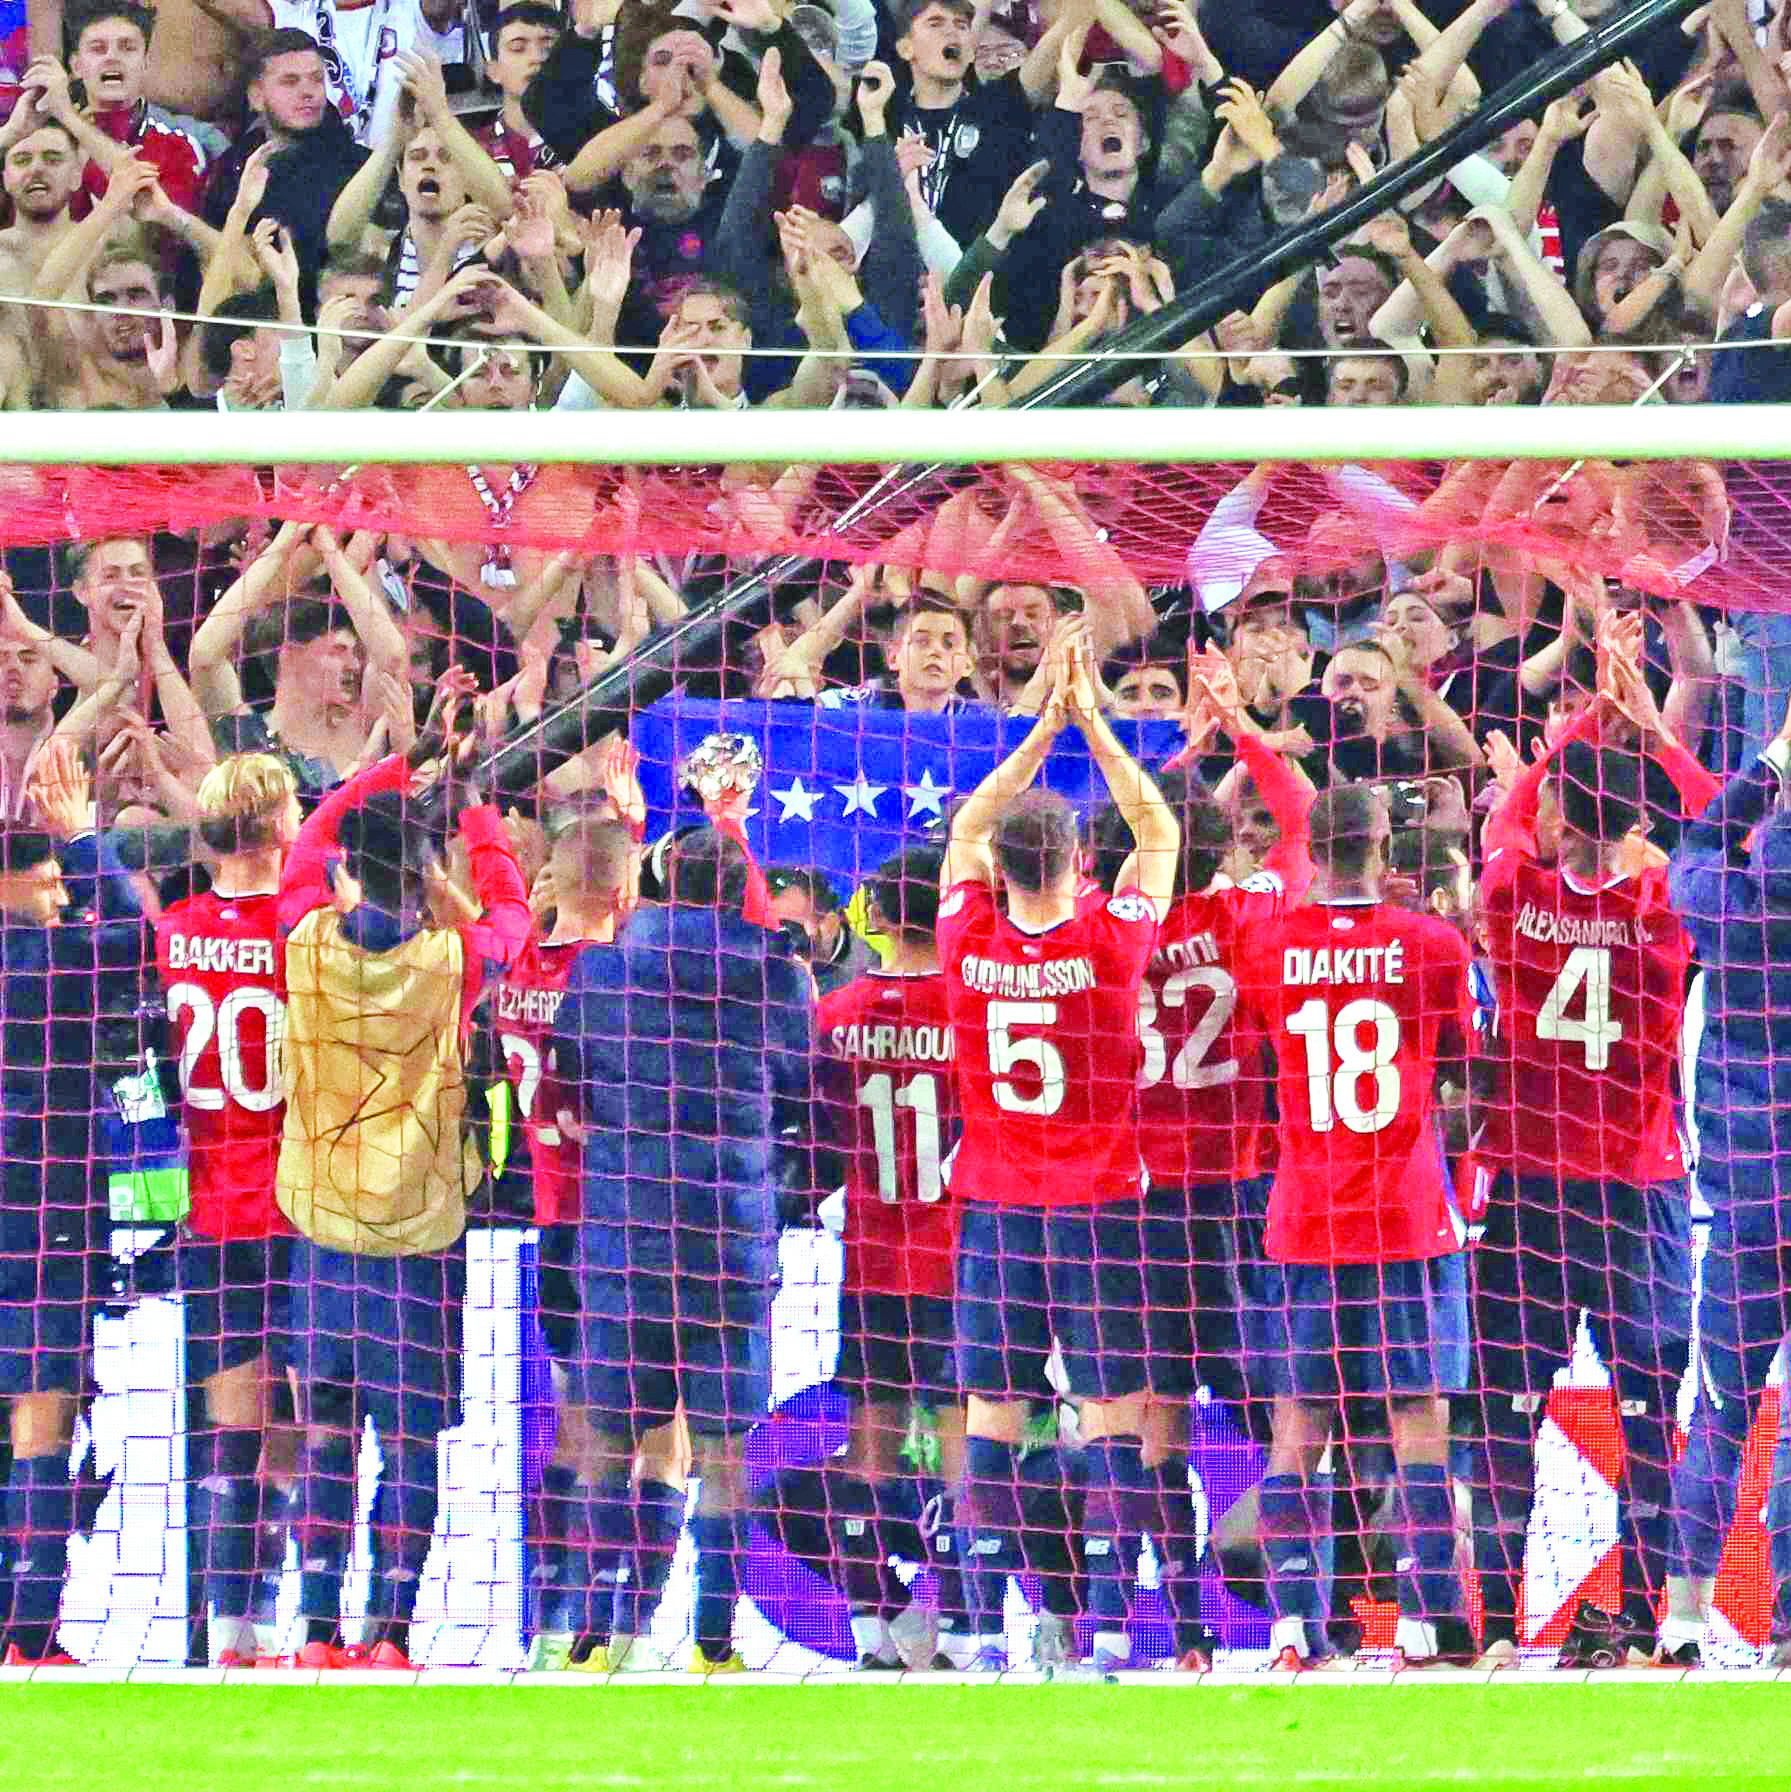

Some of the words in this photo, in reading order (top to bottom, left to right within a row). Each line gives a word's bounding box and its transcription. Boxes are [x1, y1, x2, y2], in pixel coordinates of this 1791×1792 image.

[169, 933, 274, 975] BAKKER
[1284, 942, 1403, 985] DIAKITÉ
[1536, 948, 1622, 1070] 4
[167, 982, 287, 1113] 20
[987, 999, 1065, 1115] 5
[1286, 999, 1400, 1133] 18
[856, 1074, 943, 1205] 11
